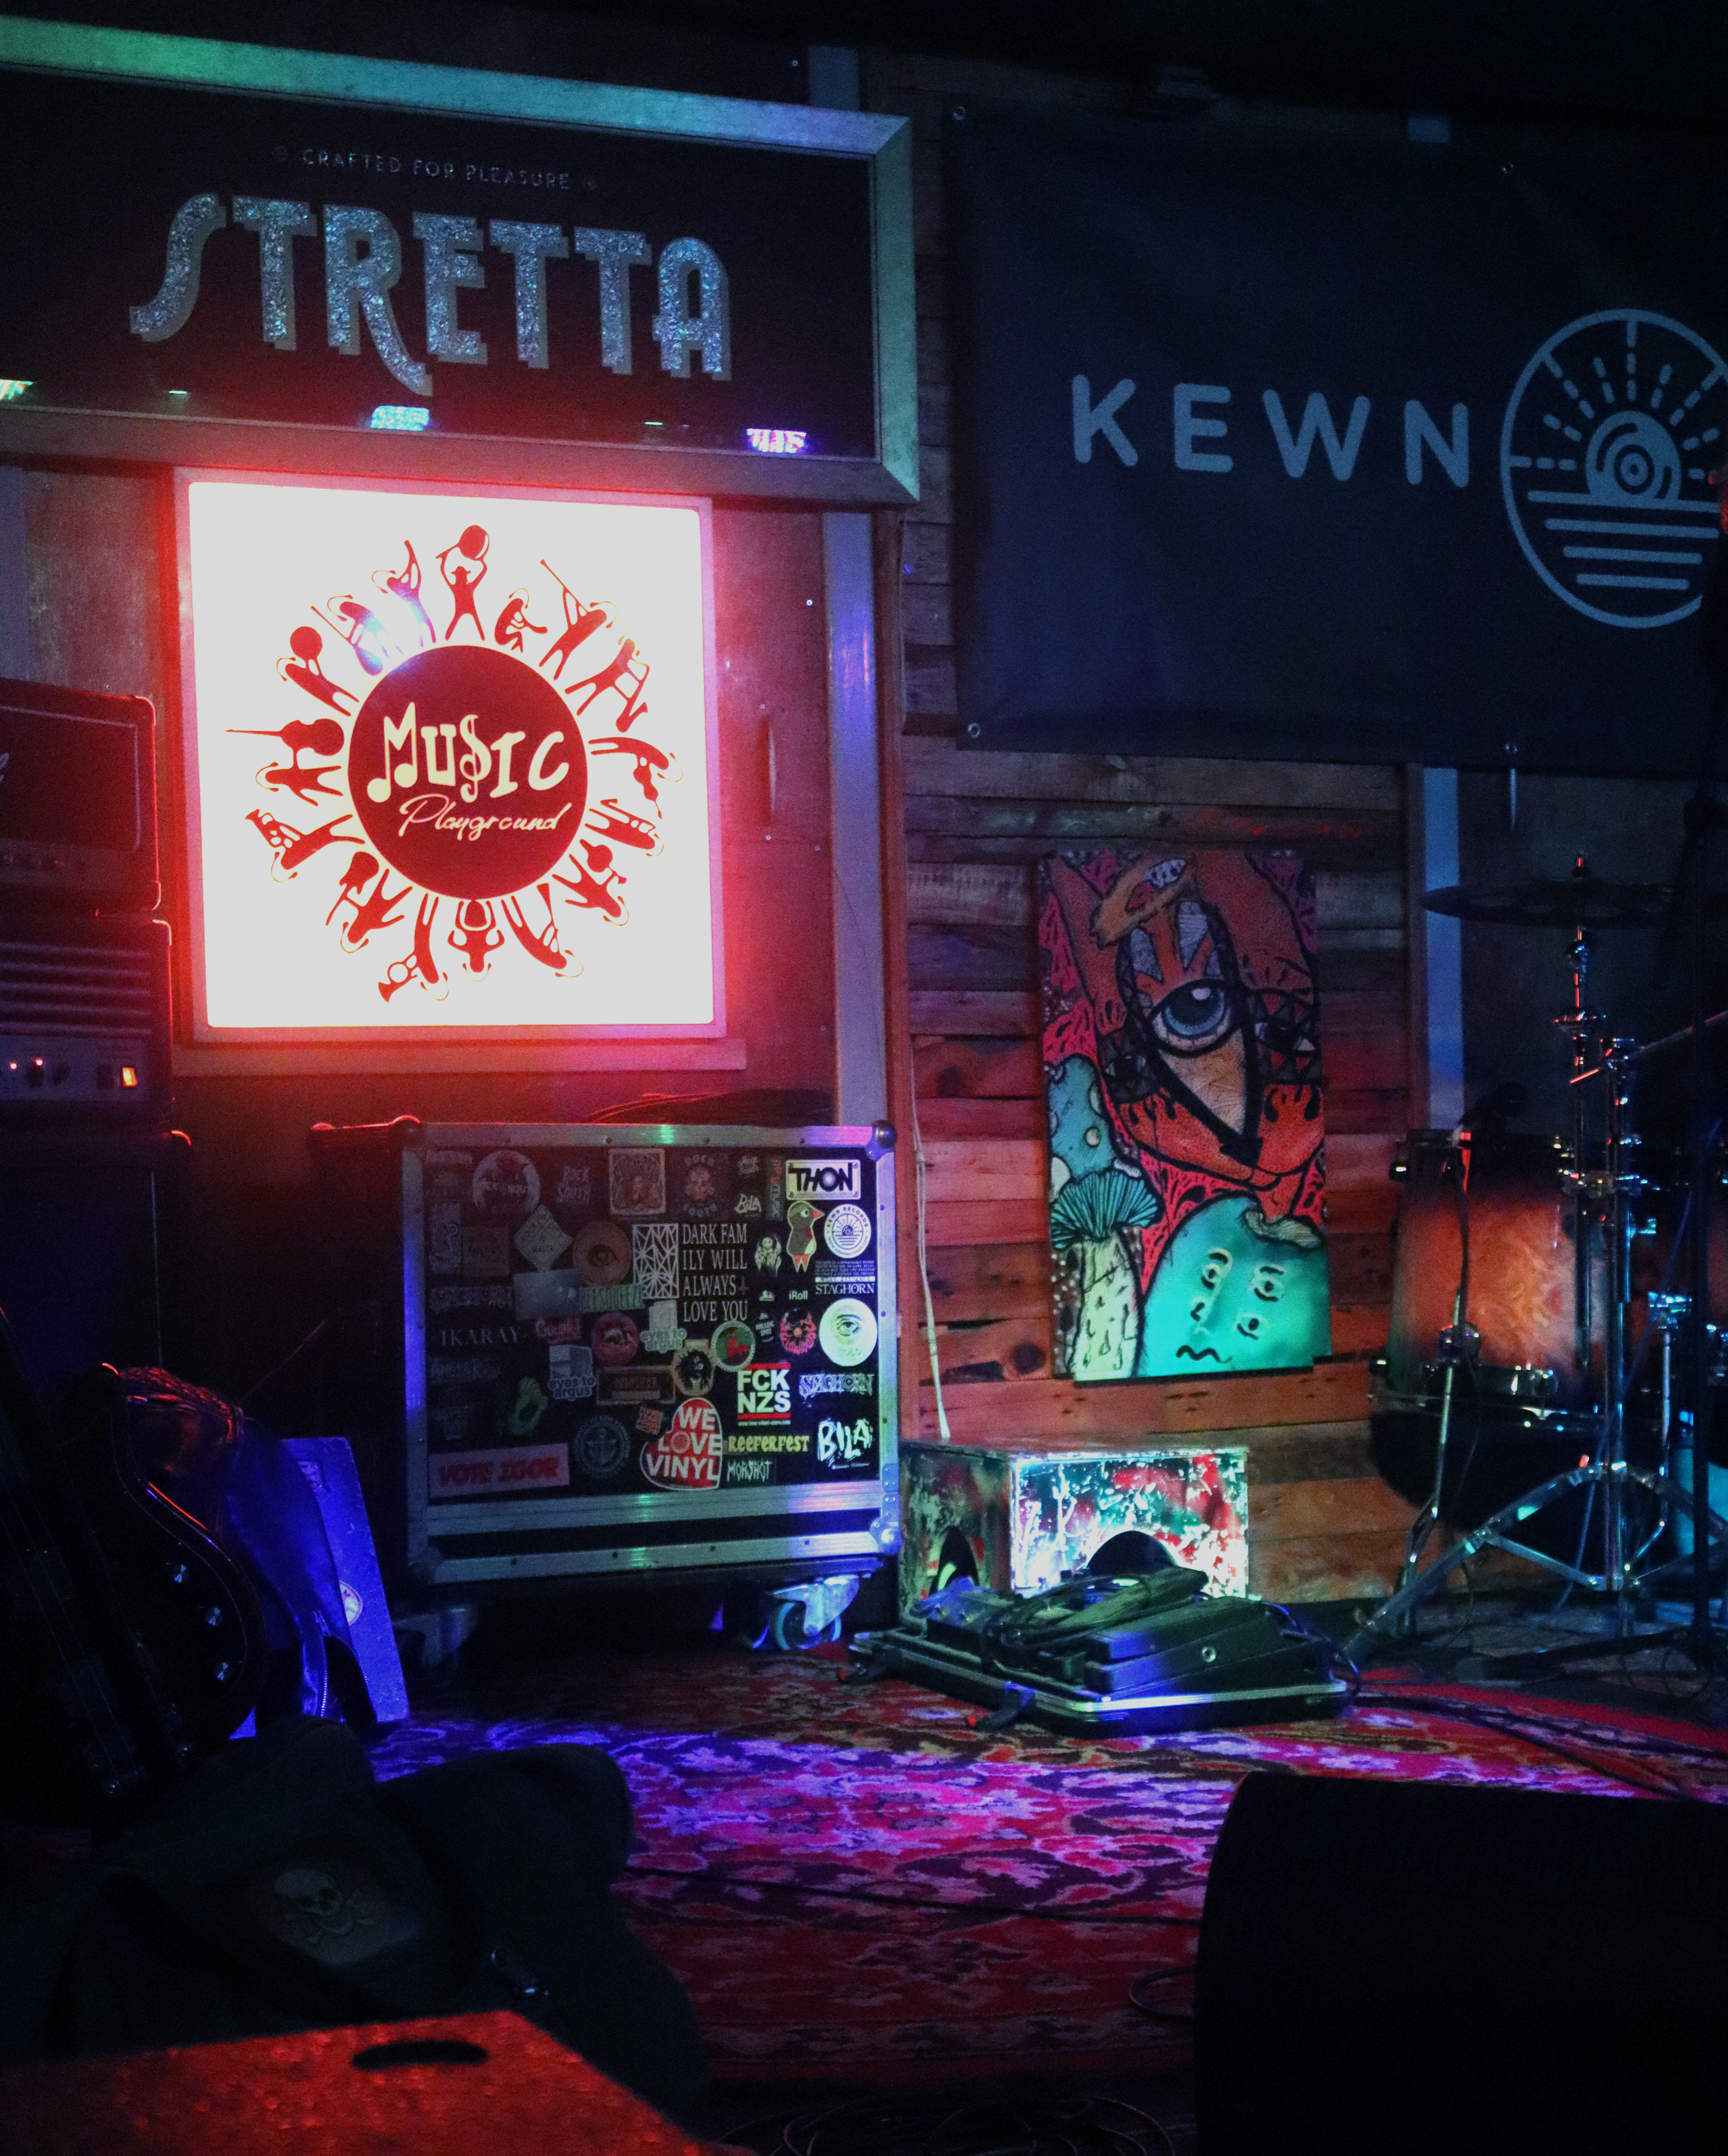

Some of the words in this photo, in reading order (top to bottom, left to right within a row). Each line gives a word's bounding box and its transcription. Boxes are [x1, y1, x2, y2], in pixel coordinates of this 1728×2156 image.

[302, 149, 400, 173] CRAFTED
[413, 160, 454, 178] FOR
[466, 164, 569, 189] PLEASURE
[130, 193, 731, 396] STRETTA
[1071, 374, 1469, 488] KEWN
[367, 701, 569, 803] MUSIC
[399, 793, 572, 840] Playground
[788, 1163, 853, 1191] THON
[843, 1206, 868, 1227] RECORDS
[683, 1224, 718, 1244] DARK
[721, 1224, 747, 1244] FAM
[683, 1249, 705, 1270] ILY
[711, 1249, 747, 1270] WILL
[683, 1275, 737, 1296] ALWAYS
[789, 1290, 808, 1300] iRoll
[816, 1283, 875, 1295] STAGHORN
[683, 1301, 718, 1322] LOVE
[722, 1300, 748, 1321] YOU
[549, 1378, 579, 1389] eyes
[581, 1376, 595, 1386] to
[737, 1369, 790, 1392] FCK
[555, 1387, 591, 1400] argus
[737, 1391, 791, 1414] NZS
[678, 1407, 716, 1431] WE
[658, 1431, 721, 1456] LOVE
[817, 1418, 872, 1463] BILA
[646, 1454, 719, 1481] VINYL
